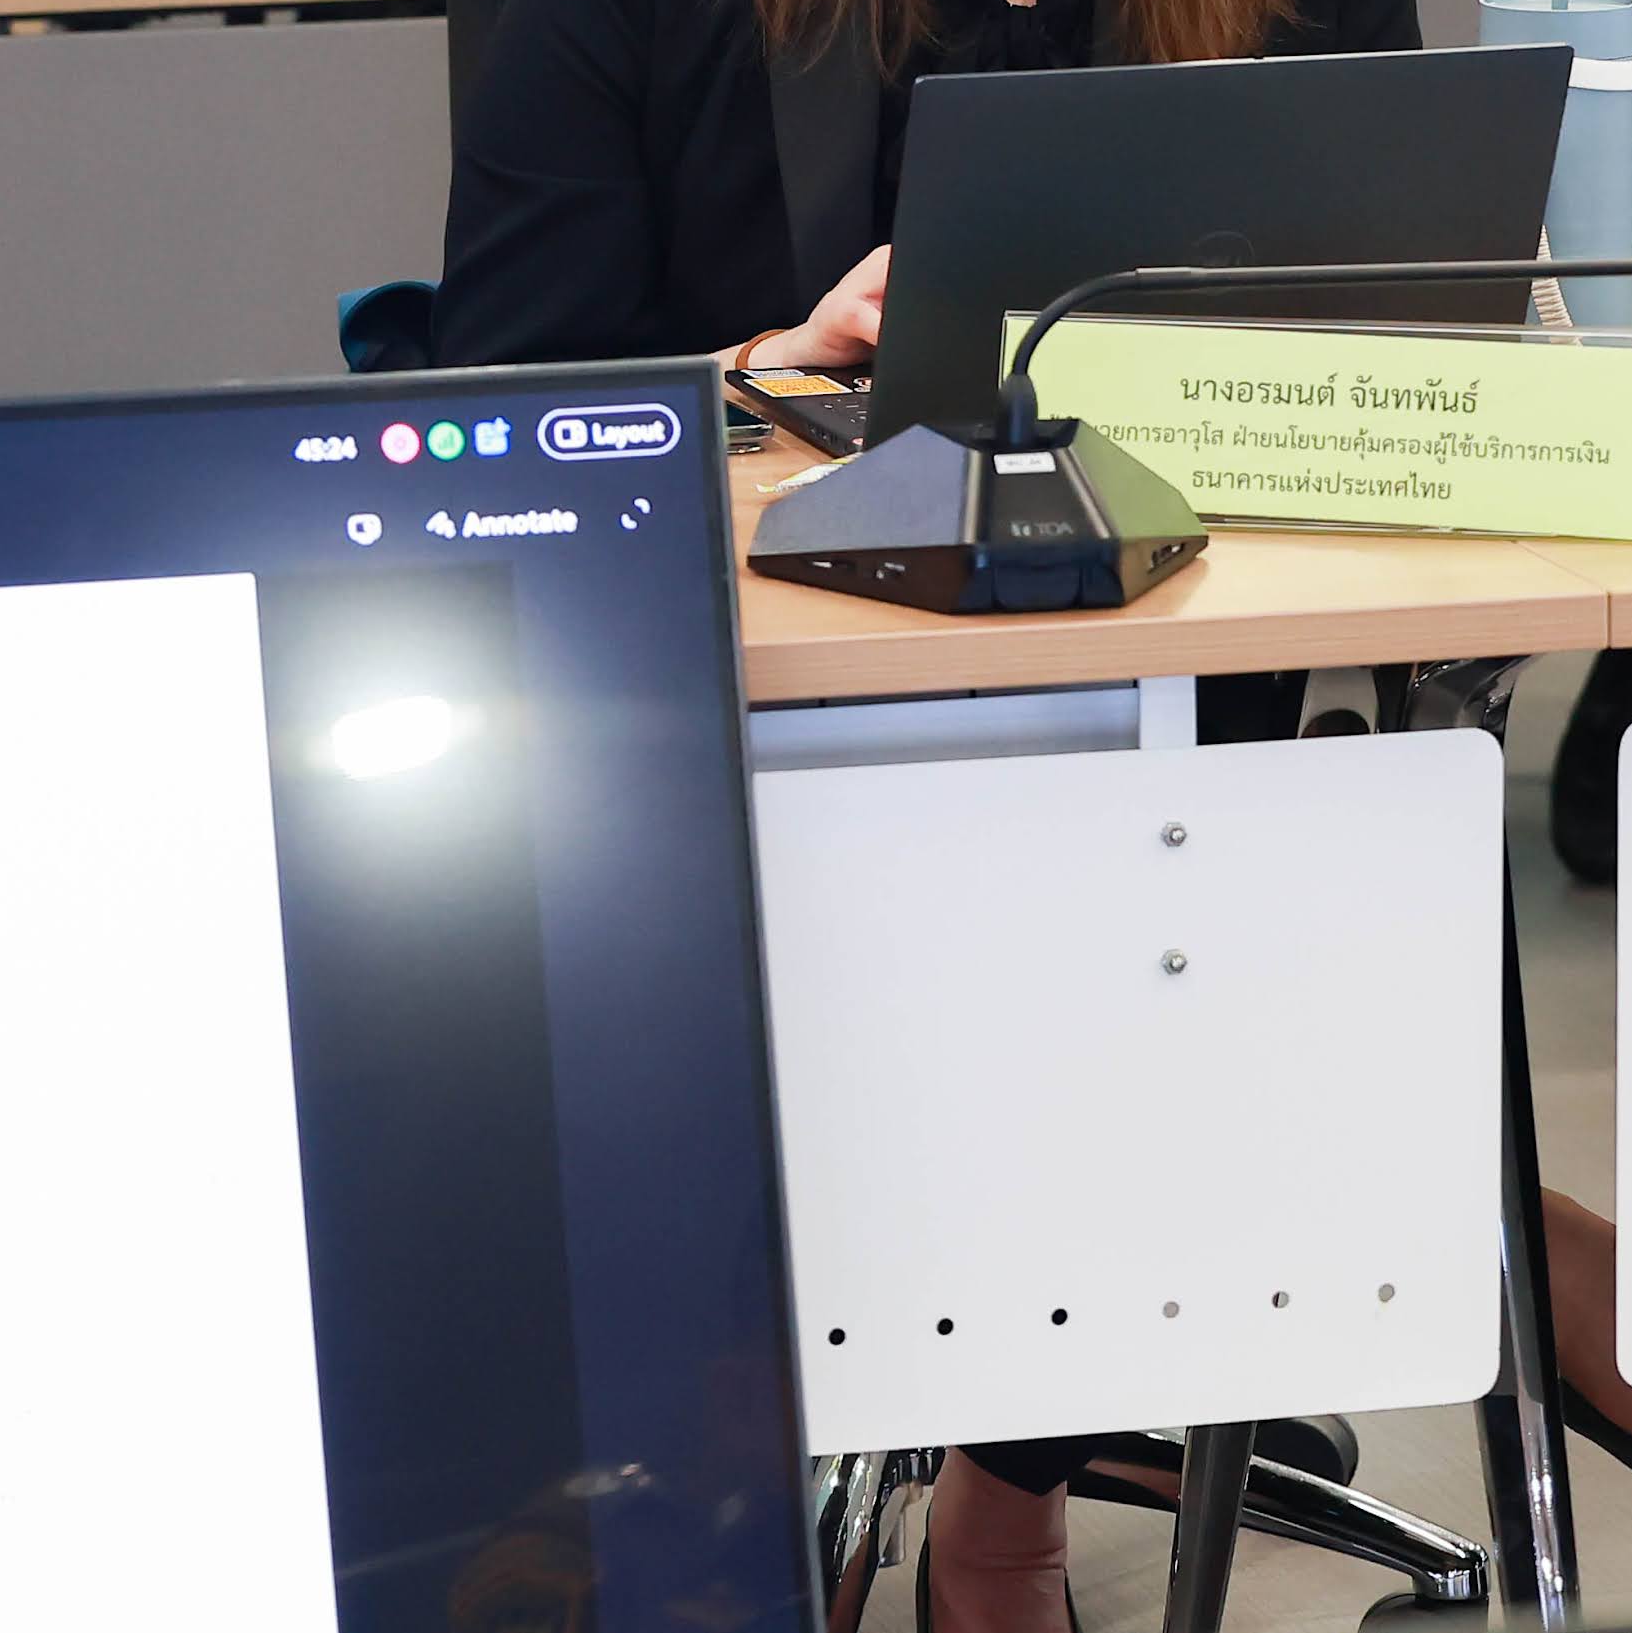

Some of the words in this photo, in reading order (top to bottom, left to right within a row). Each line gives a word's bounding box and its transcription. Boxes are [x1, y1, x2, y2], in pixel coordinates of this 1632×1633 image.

[1180, 371, 1337, 407] นางอรมนต์
[1349, 374, 1481, 415] จันทพันธ์
[592, 422, 666, 449] Layout
[1191, 469, 1452, 501] ธนาคารแห่งประเทศไทย
[463, 509, 578, 537] Annotate
